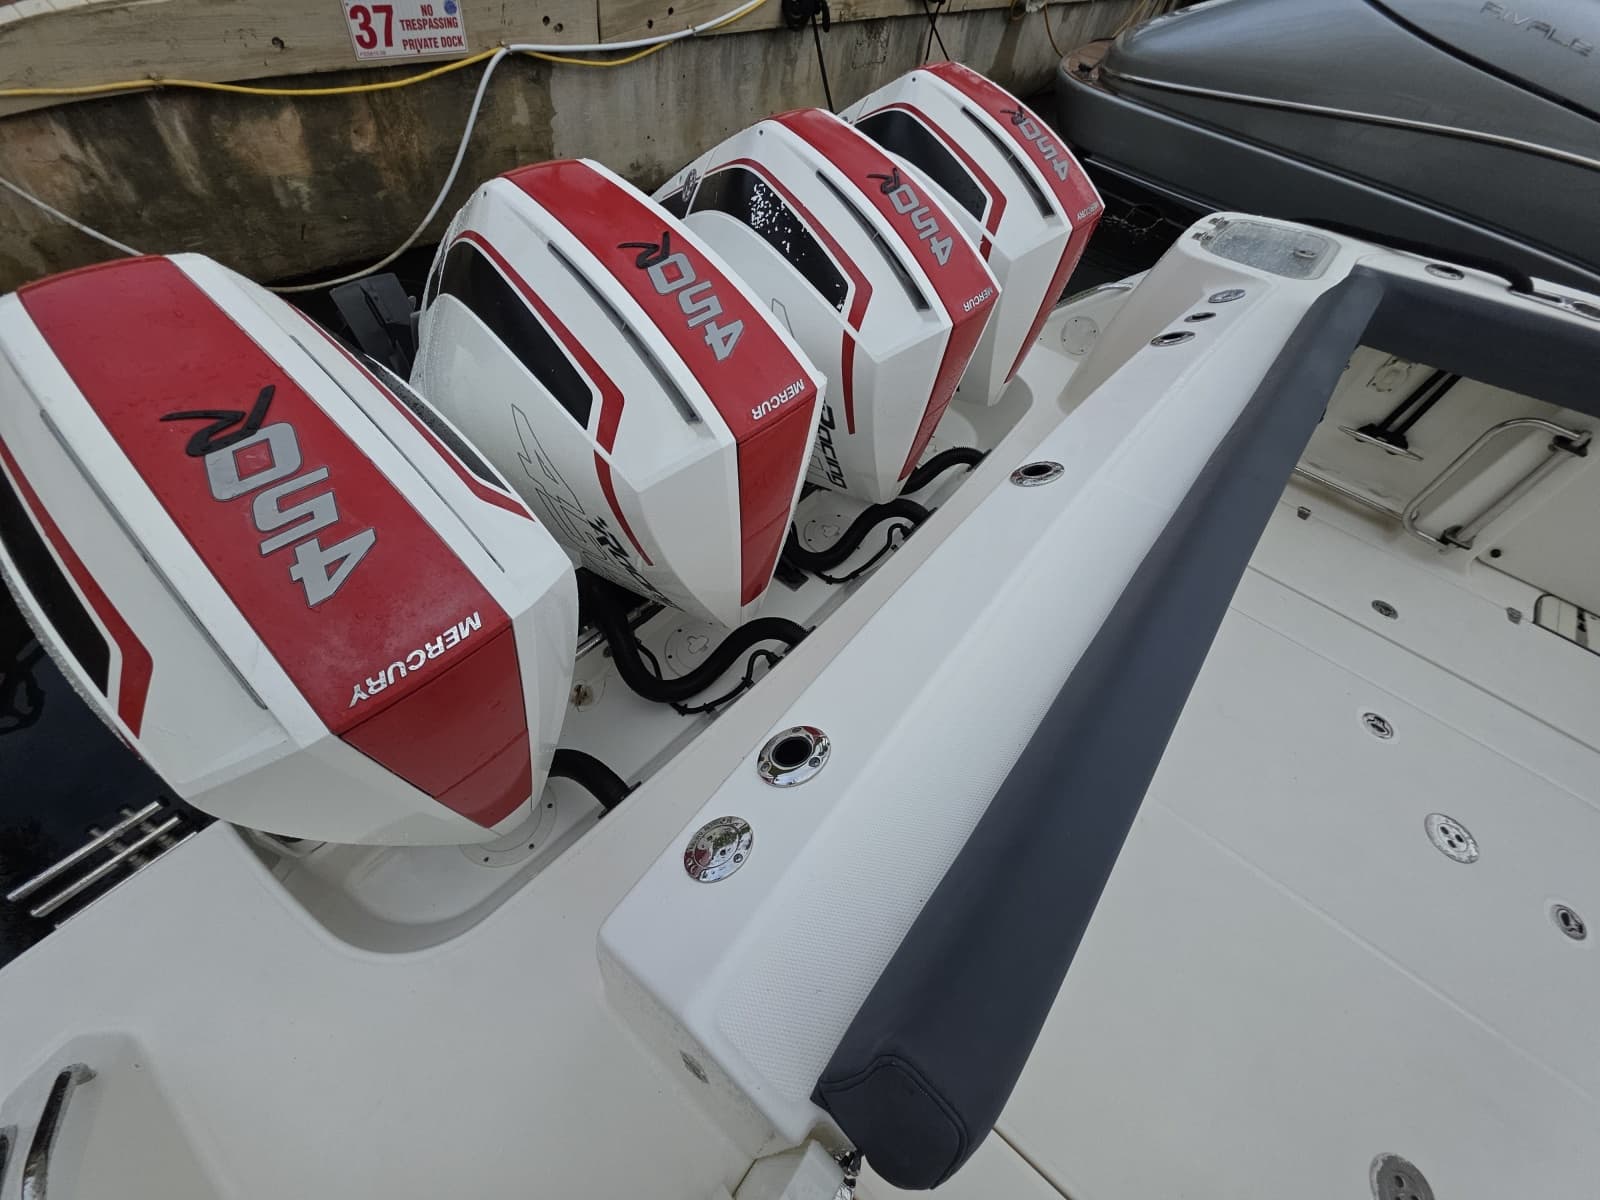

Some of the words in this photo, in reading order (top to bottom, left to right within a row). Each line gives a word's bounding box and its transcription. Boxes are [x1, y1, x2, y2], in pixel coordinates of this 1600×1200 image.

[349, 4, 394, 49] 37
[399, 17, 459, 31] TRESPASSING
[420, 4, 434, 17] NO
[402, 37, 439, 52] PRIVATE
[441, 36, 464, 48] DOCK
[617, 231, 745, 361] 450R
[158, 384, 377, 608] 450R
[348, 610, 483, 708] MERCURY
